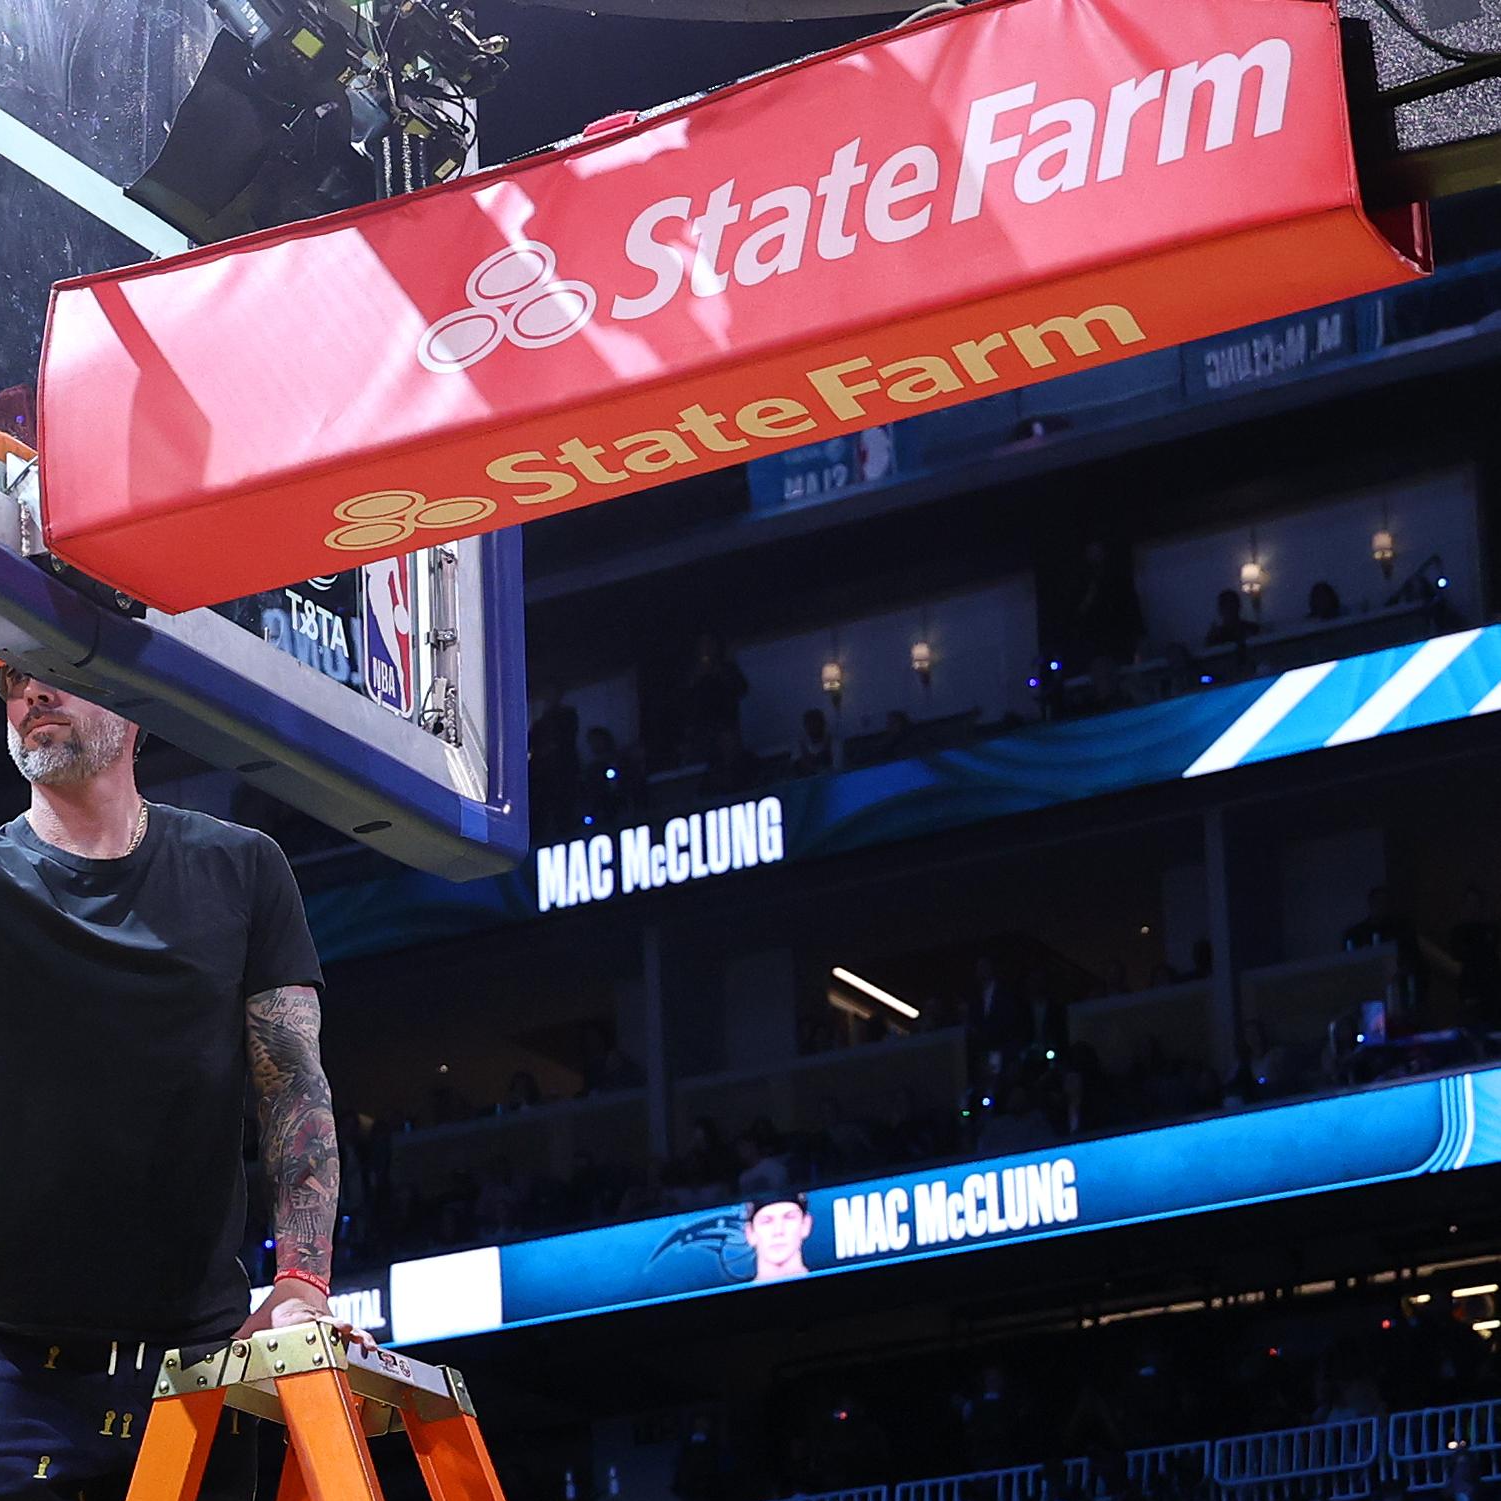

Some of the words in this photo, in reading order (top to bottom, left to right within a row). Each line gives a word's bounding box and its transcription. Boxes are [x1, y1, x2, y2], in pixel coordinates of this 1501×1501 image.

[372, 656, 396, 699] NBA
[538, 834, 614, 912] MAC
[620, 797, 784, 892] McCLUNG
[834, 1192, 910, 1260] MAC
[916, 1159, 1078, 1246] McCLUNG
